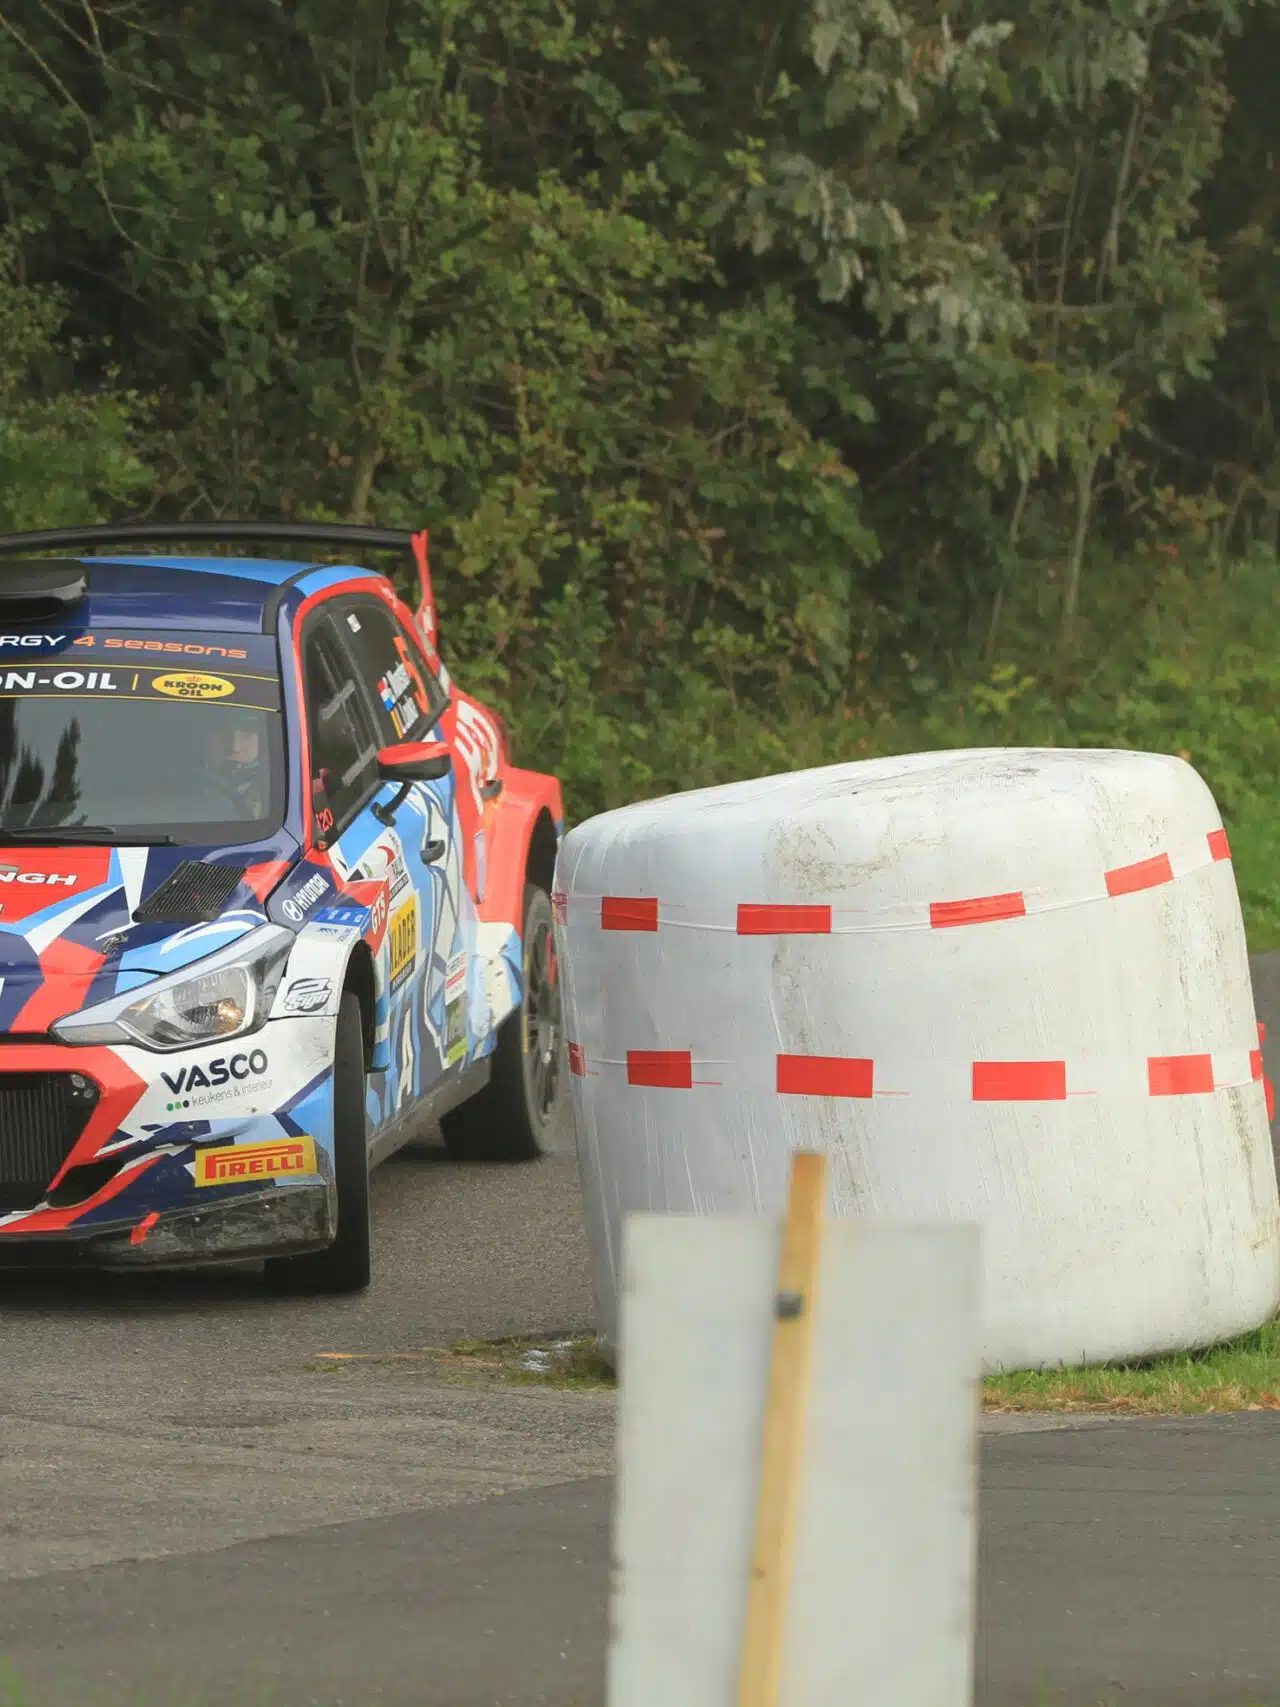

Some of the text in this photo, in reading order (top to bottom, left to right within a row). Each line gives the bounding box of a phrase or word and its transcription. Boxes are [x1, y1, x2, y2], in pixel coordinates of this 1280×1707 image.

[73, 635, 96, 647] 4
[103, 638, 248, 659] seasons
[163, 680, 223, 691] KROON
[178, 688, 203, 697] OIL
[296, 872, 331, 911] HYUNDAI
[160, 1048, 268, 1095] VASCO
[192, 1088, 233, 1107] keukens
[234, 1085, 241, 1097] &
[204, 1143, 304, 1180] PIRELLI
